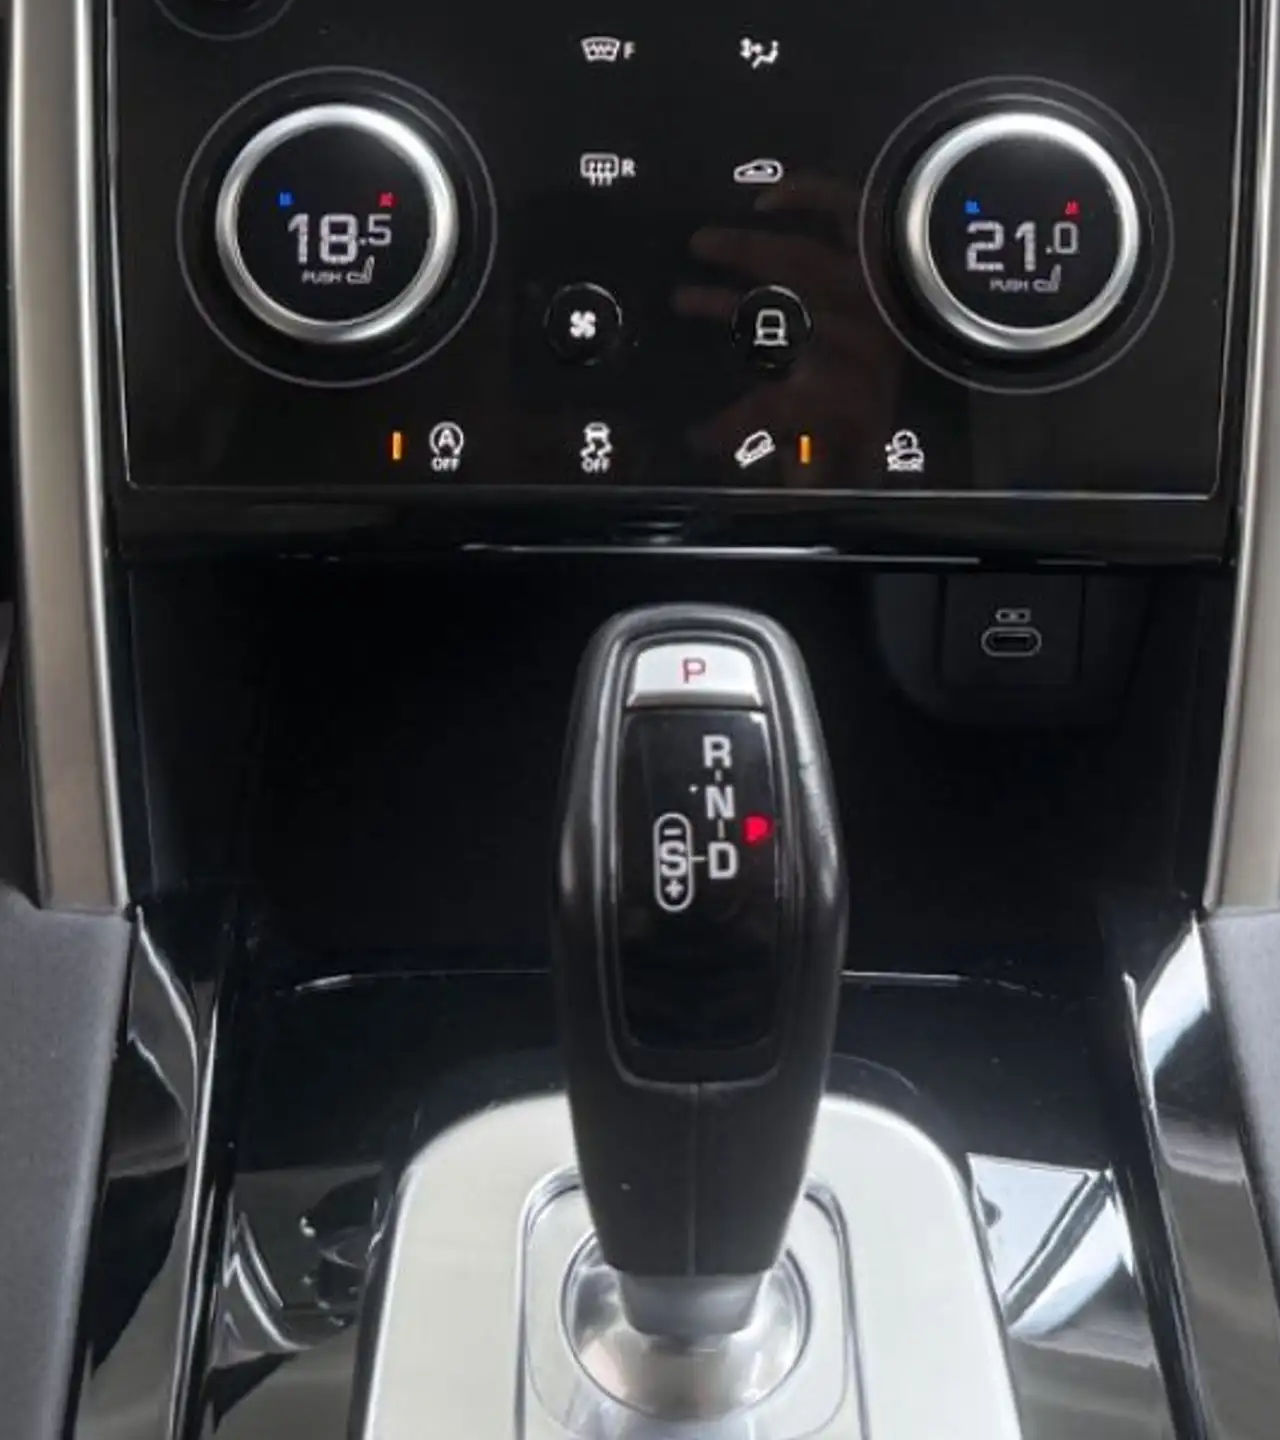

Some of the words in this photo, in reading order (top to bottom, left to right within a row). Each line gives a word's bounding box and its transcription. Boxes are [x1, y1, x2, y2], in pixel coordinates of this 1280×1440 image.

[623, 42, 636, 60] F
[621, 160, 636, 177] R
[302, 269, 342, 284] PUSH
[989, 278, 1030, 292] PUSH
[431, 456, 460, 471] OFF
[582, 457, 610, 472] OFF
[681, 658, 707, 684] P
[702, 734, 733, 768] R
[705, 785, 735, 818] N
[659, 841, 687, 877] S
[707, 842, 739, 879] D
